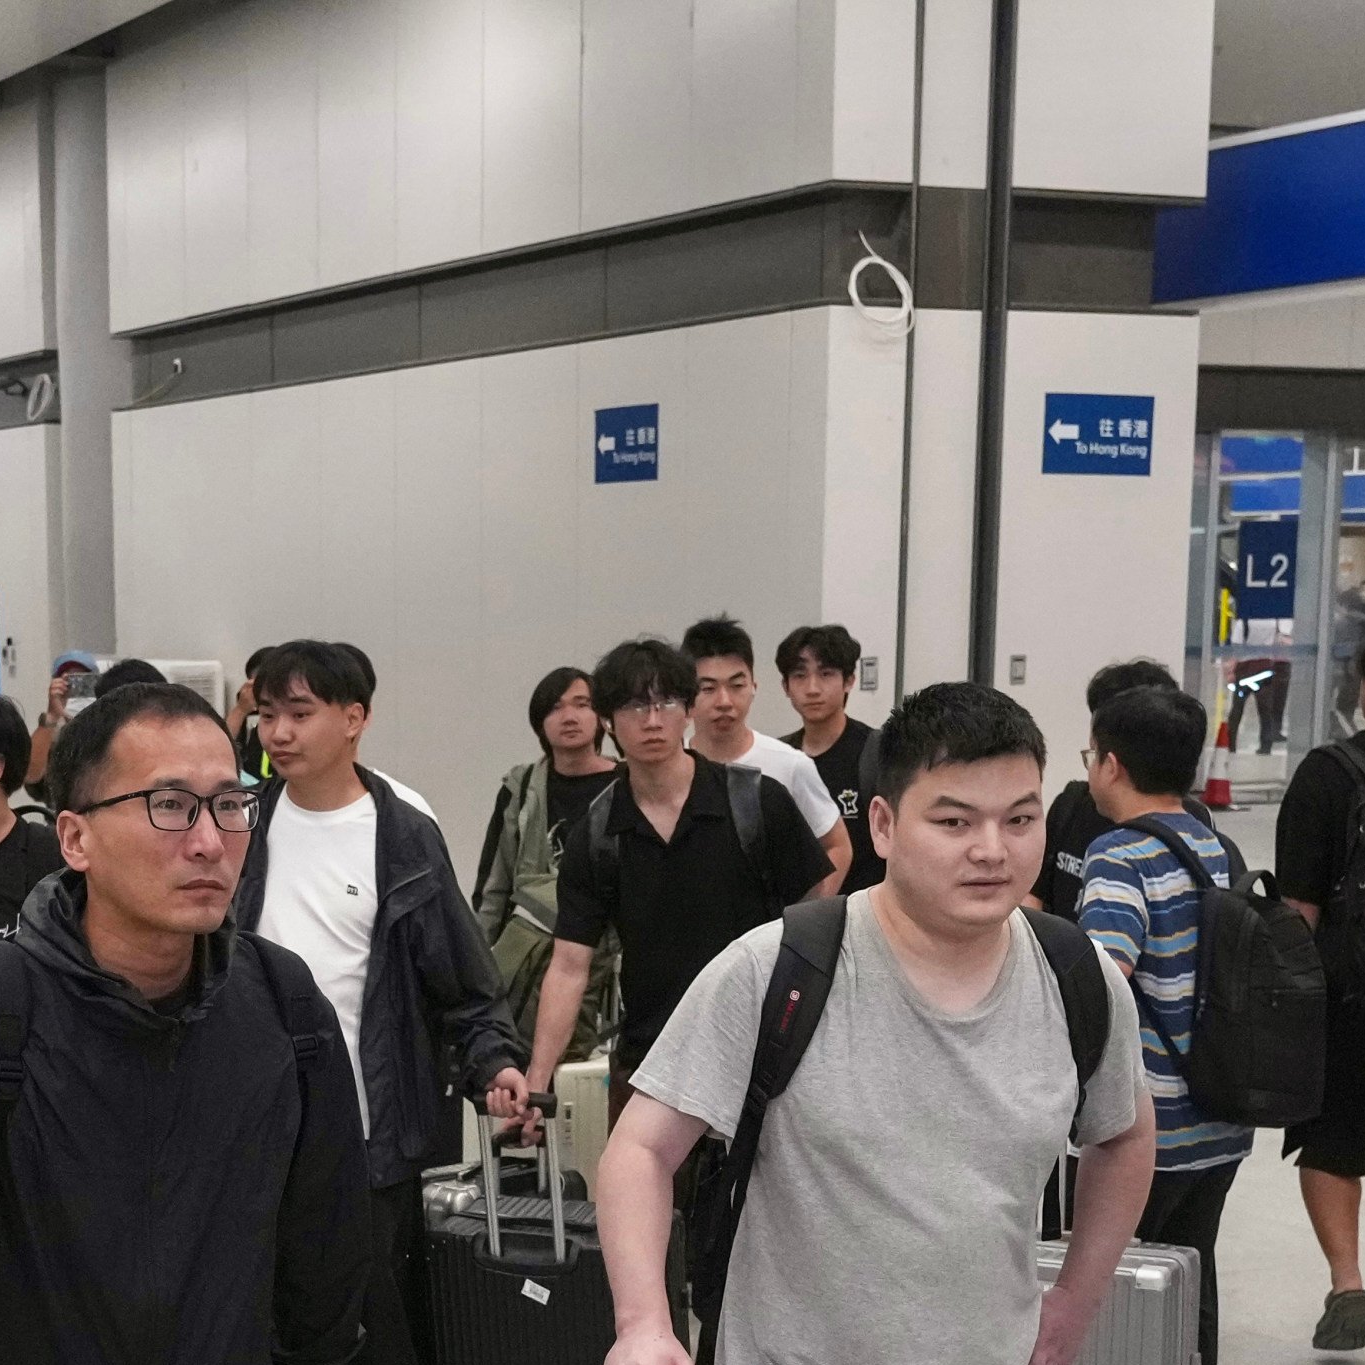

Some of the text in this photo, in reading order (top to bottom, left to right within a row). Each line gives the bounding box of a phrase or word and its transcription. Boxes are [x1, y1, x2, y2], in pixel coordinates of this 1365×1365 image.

[1075, 440, 1148, 460] To Hong Kong
[1245, 553, 1289, 588] L2
